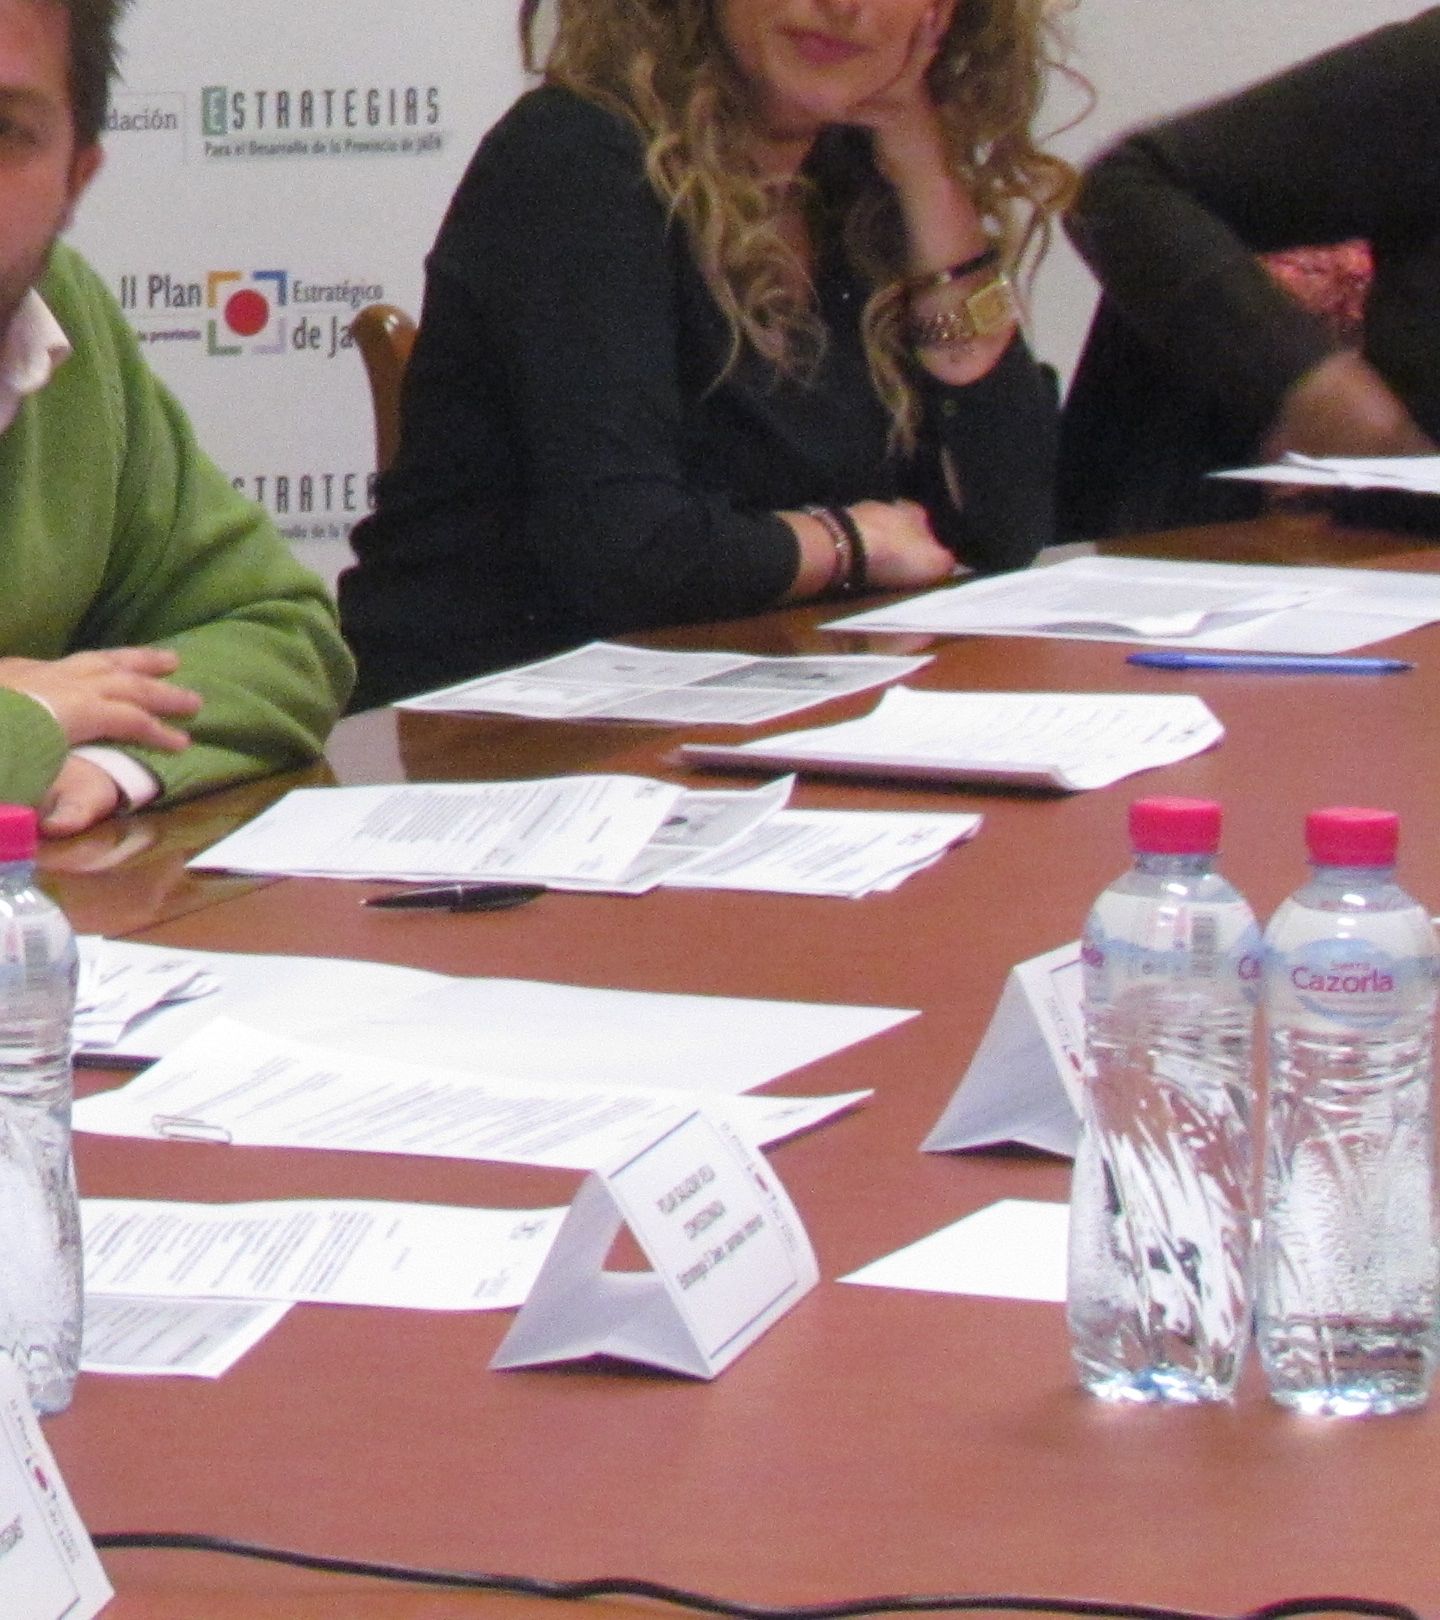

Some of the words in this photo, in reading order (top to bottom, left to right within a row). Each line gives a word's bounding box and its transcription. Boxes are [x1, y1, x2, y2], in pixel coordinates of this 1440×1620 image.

[102, 107, 178, 131] dación
[207, 86, 440, 130] ESTRATEGIAS
[120, 275, 137, 310] II
[148, 274, 202, 309] Plan
[292, 279, 384, 309] Estratégico
[292, 315, 321, 350] de
[327, 315, 355, 358] Ja
[1291, 966, 1395, 993] Cazorla
